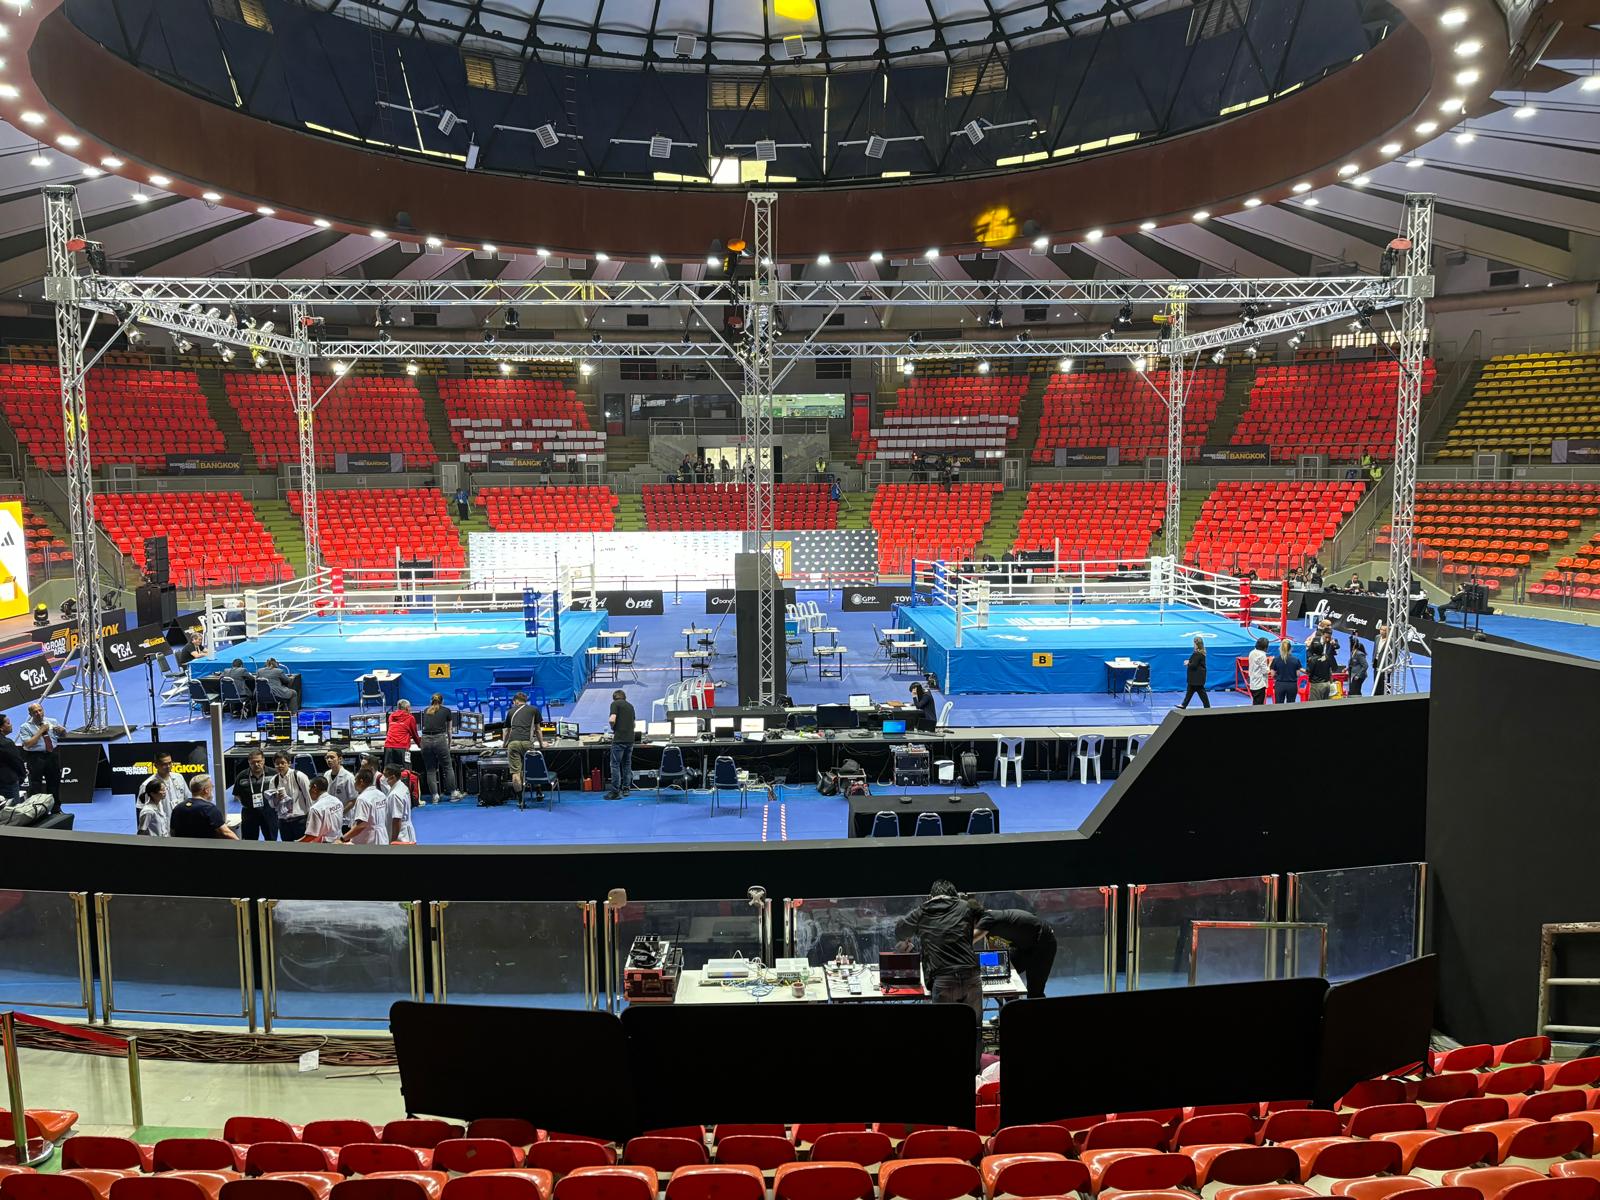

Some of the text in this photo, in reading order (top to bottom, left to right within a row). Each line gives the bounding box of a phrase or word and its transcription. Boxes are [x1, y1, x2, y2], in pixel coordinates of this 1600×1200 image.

[636, 598, 654, 608] ptt
[1039, 656, 1047, 664] B
[436, 666, 444, 675] A
